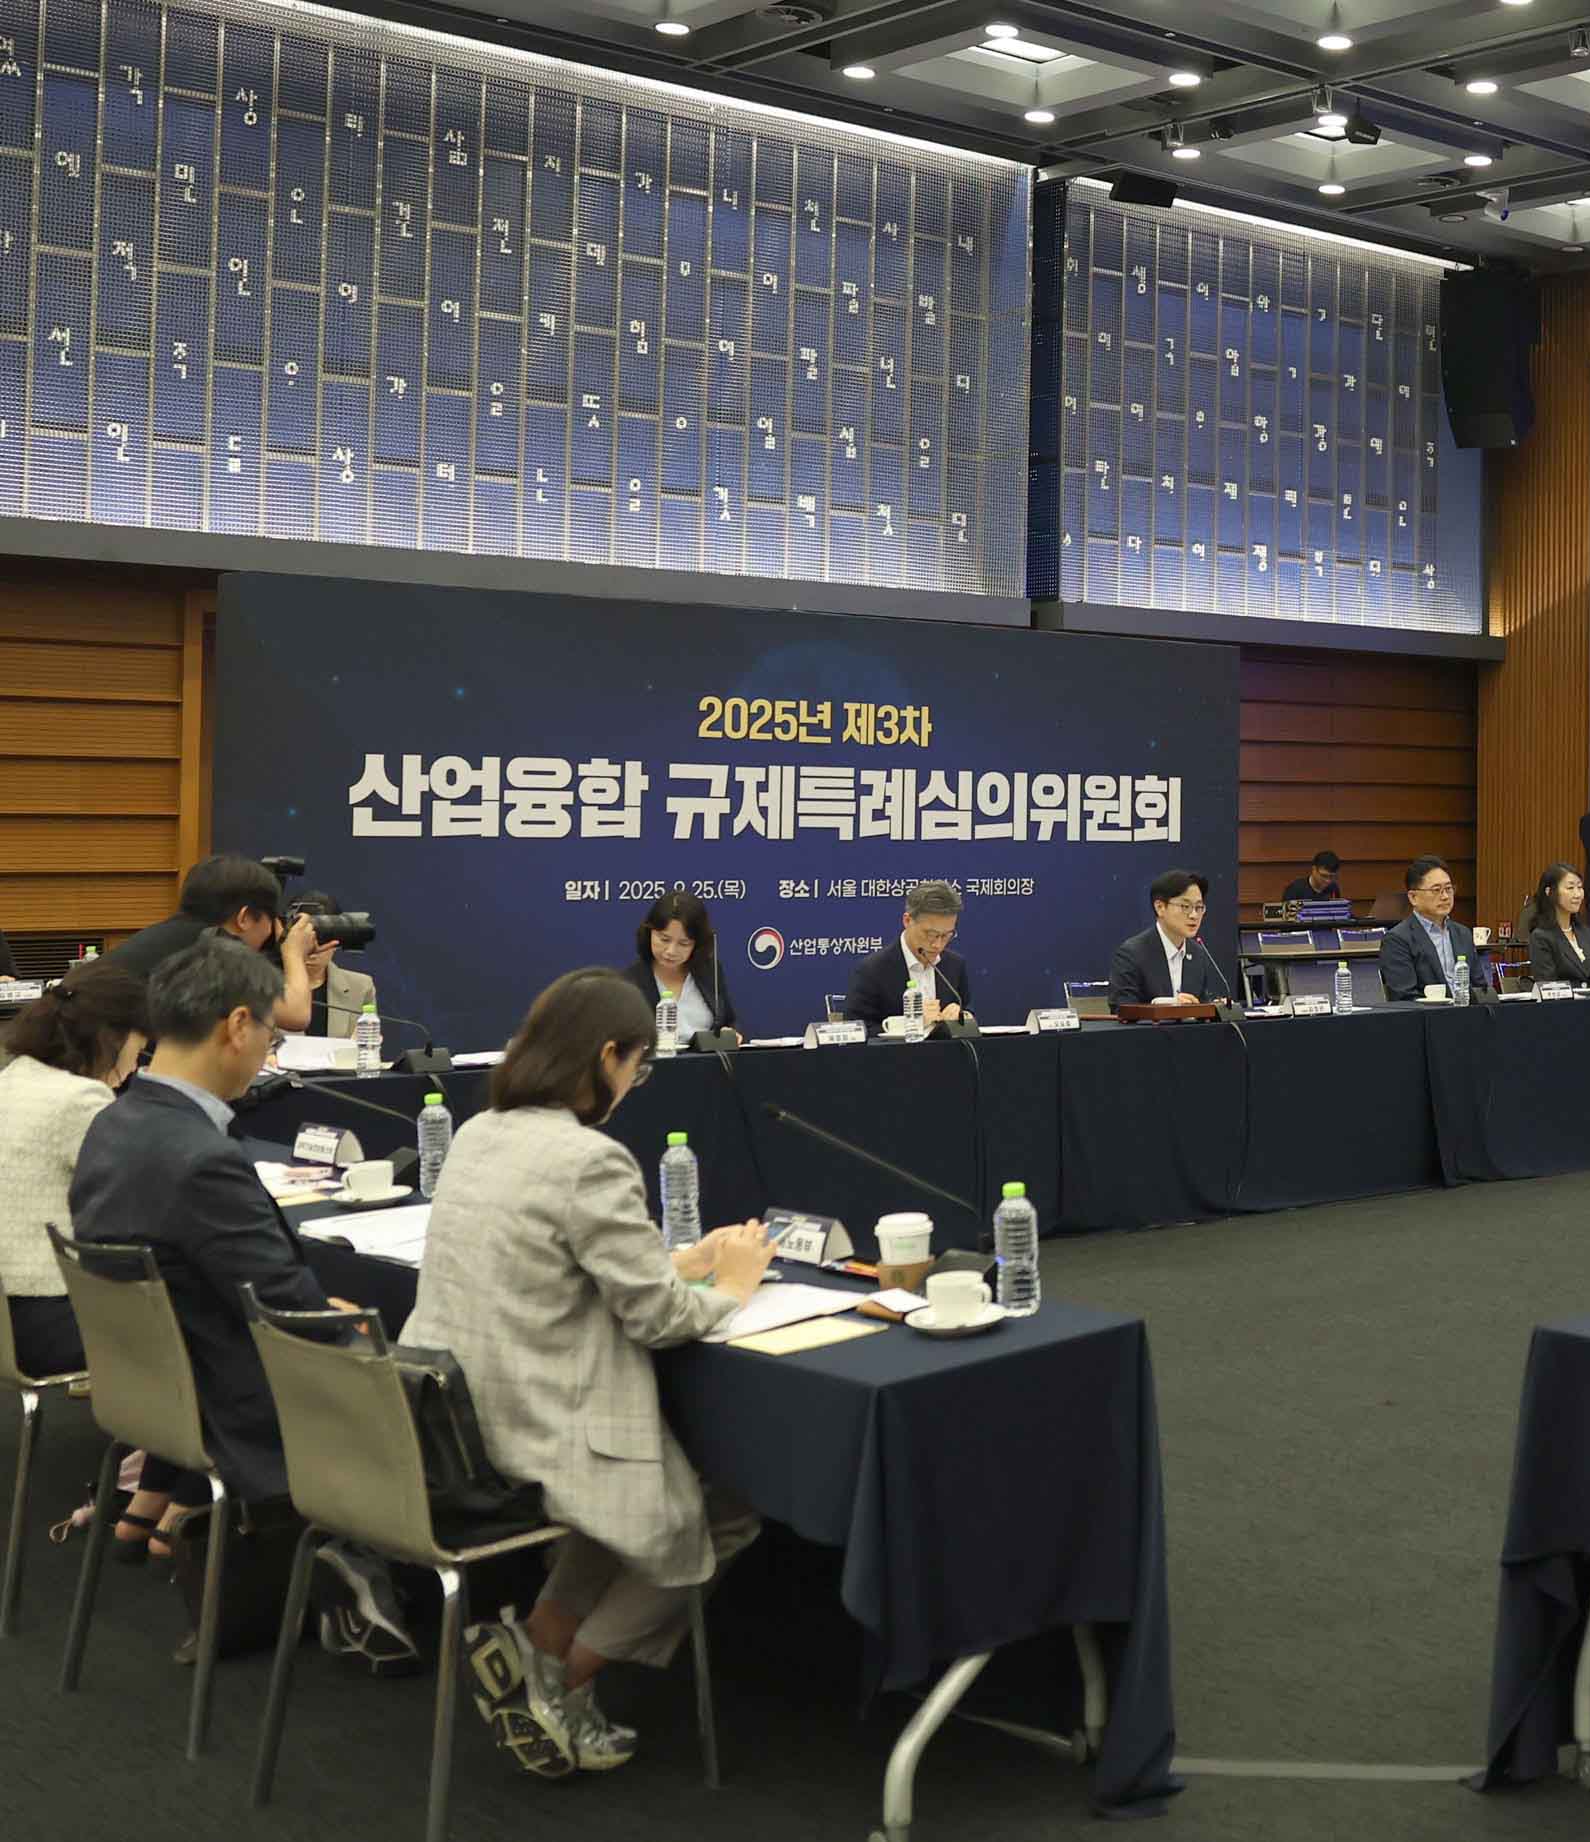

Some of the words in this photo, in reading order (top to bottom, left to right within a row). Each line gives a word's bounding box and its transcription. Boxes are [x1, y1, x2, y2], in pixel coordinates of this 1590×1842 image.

[119, 65, 143, 104] 각
[235, 87, 257, 125] 상
[174, 164, 196, 202] 민
[228, 257, 250, 295] 인
[48, 327, 72, 366] 선
[107, 422, 130, 462] 인
[332, 447, 354, 483] 상
[698, 696, 832, 745] 2025년
[842, 702, 932, 748] 제3차
[348, 753, 649, 840] 산업융합
[666, 762, 1182, 843] 규제특례심의위원회
[692, 880, 746, 900] 25.(목)
[827, 879, 857, 897] 서울
[966, 878, 1035, 897] 국제회의장
[789, 936, 883, 956] 산업통상자원부
